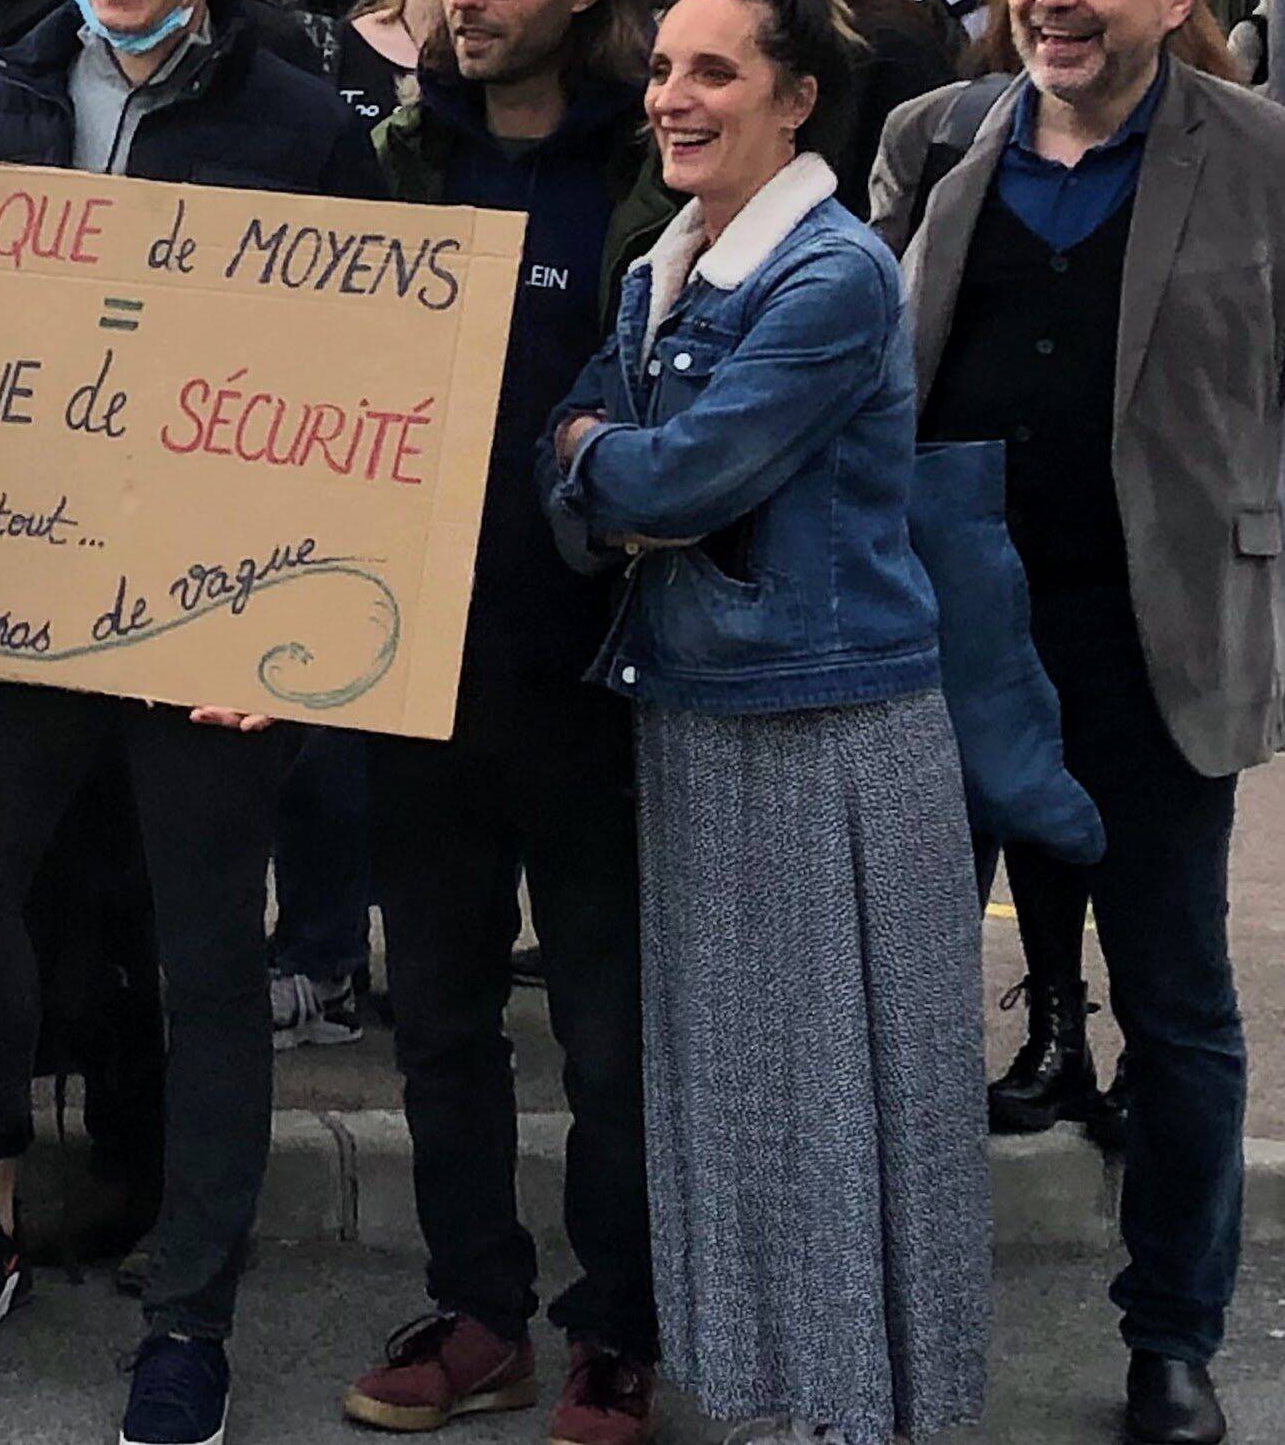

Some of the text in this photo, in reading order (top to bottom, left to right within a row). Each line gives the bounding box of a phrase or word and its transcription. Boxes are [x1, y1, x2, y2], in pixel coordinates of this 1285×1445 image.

[148, 199, 196, 273] de
[225, 219, 461, 311] MOYENS
[65, 349, 128, 439] de
[90, 576, 154, 640] de
[169, 537, 321, 615] vague
